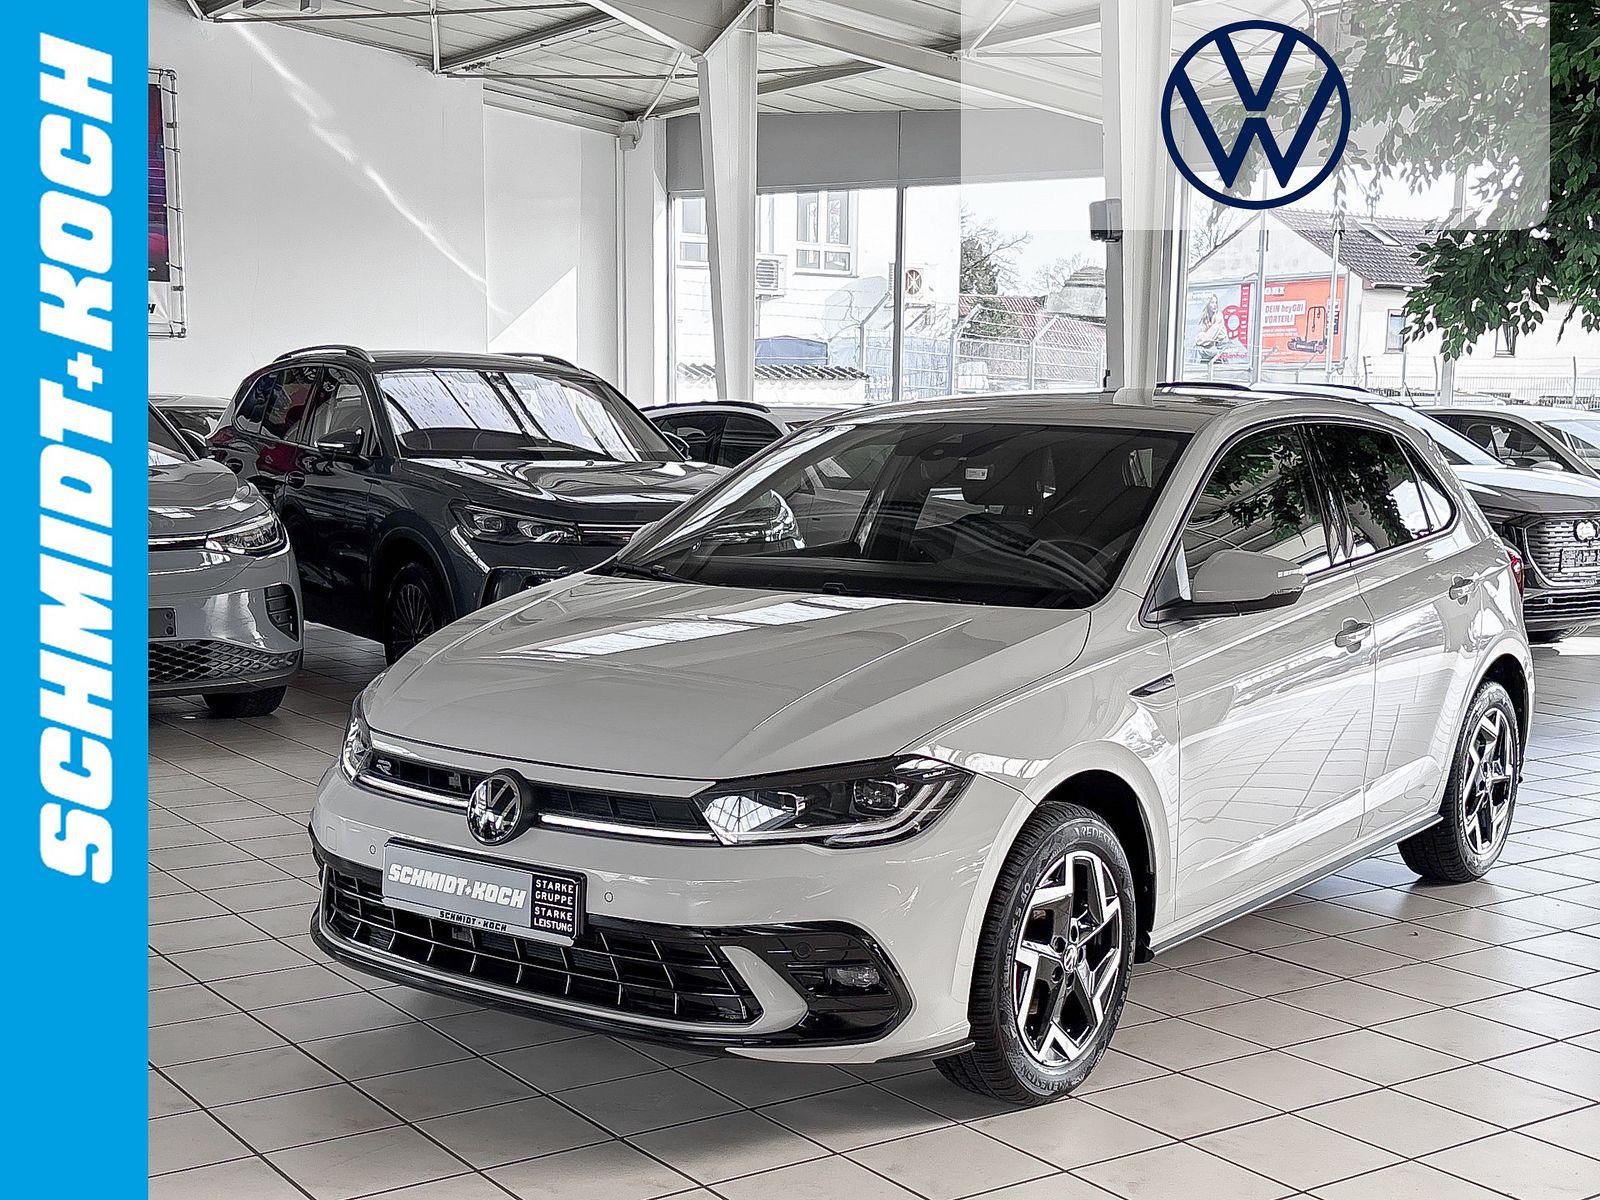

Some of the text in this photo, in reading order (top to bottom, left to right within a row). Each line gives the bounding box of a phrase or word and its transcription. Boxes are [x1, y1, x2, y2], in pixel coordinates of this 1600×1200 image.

[535, 879, 574, 894] STARKE
[535, 890, 573, 906] GRUPPE
[534, 906, 573, 922] STARKE
[483, 920, 508, 932] KOCH
[534, 917, 573, 933] LEISTUNG
